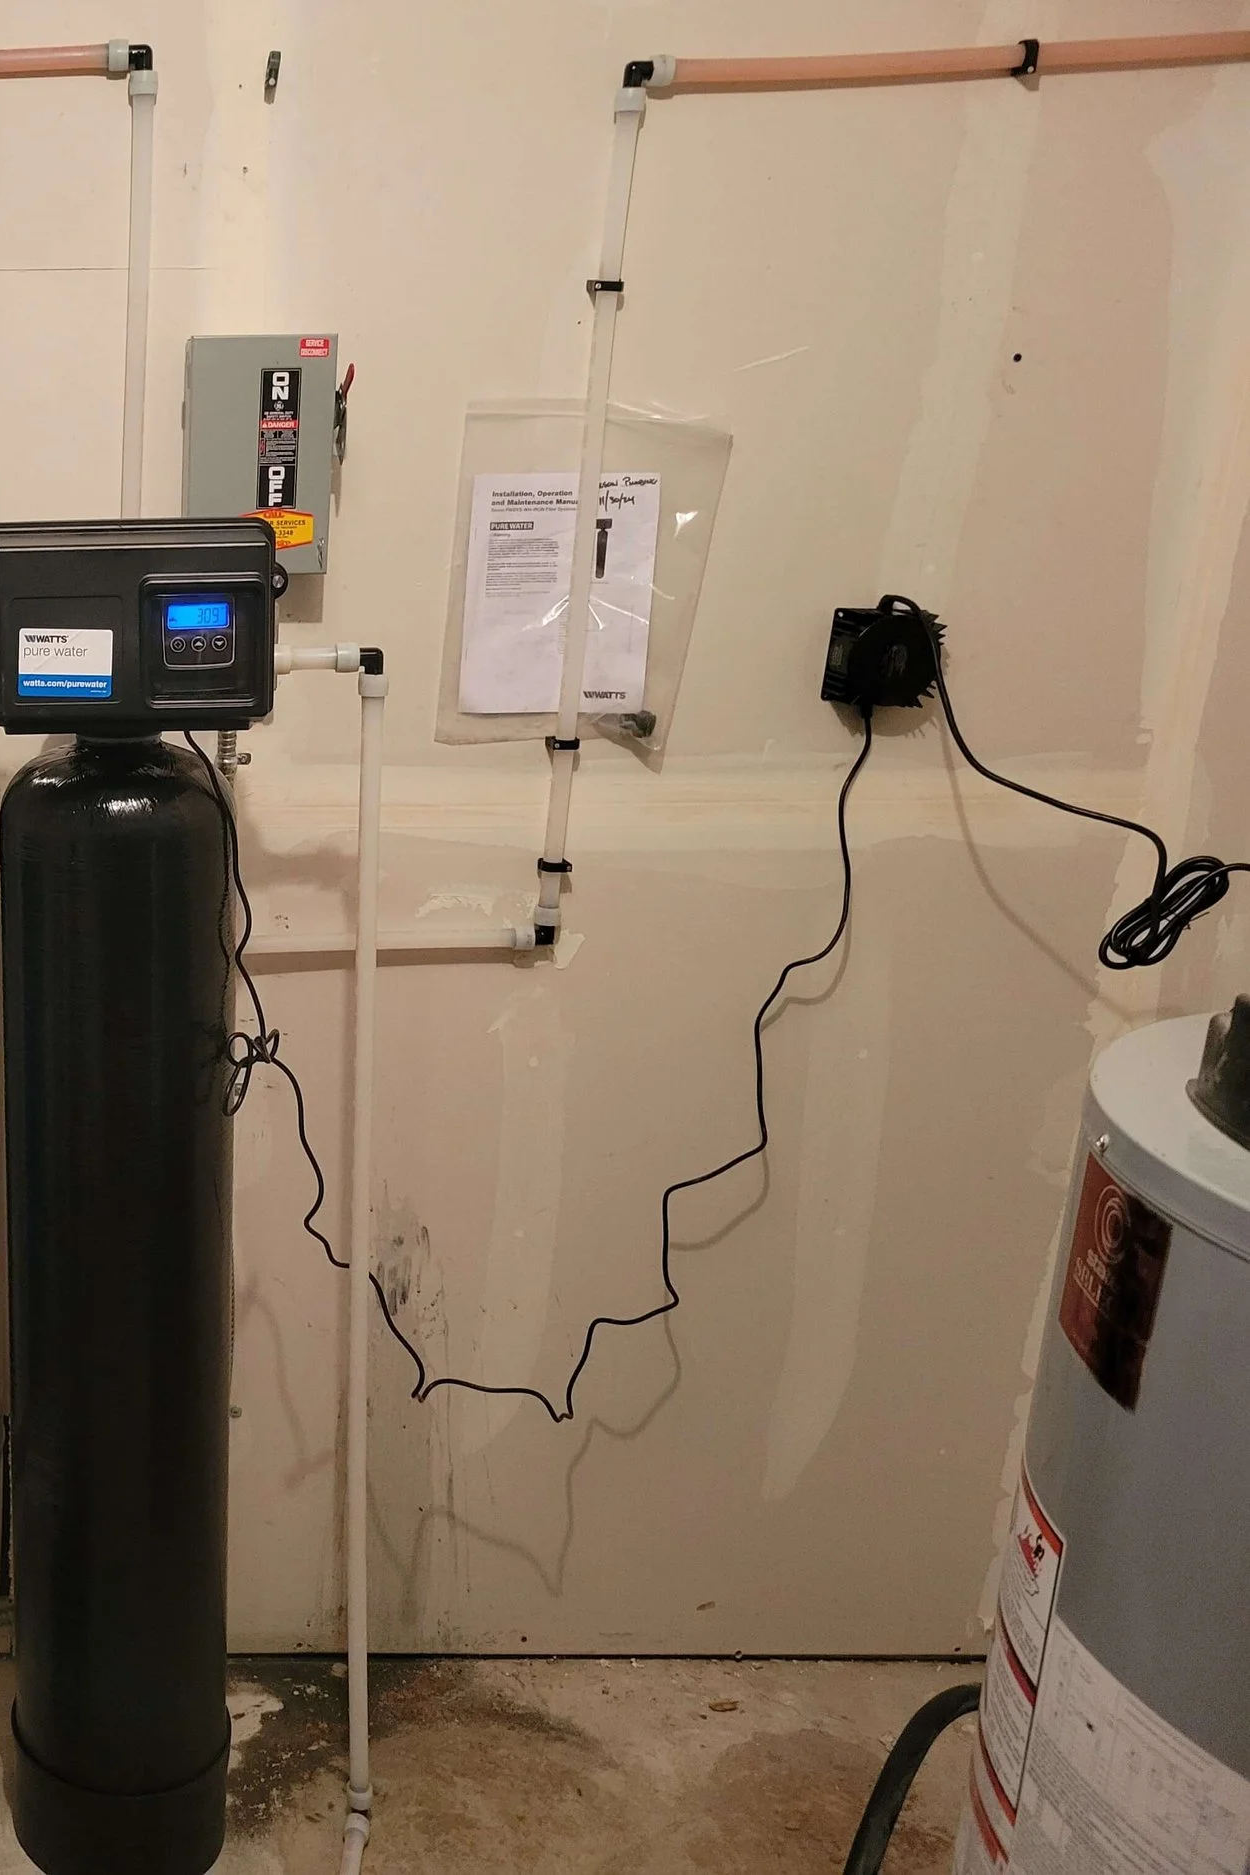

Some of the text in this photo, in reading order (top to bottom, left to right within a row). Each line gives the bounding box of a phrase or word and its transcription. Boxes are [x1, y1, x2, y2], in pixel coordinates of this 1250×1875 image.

[305, 339, 324, 347] SERVICE
[271, 371, 290, 400] ON
[268, 466, 285, 507] OFF
[492, 490, 573, 498] Installation, Operation
[490, 522, 533, 530] PURE WATER
[31, 635, 69, 643] WATTS
[23, 646, 88, 658] pure water
[22, 679, 108, 689] watts.com/purewater
[589, 691, 627, 699] WATTS
